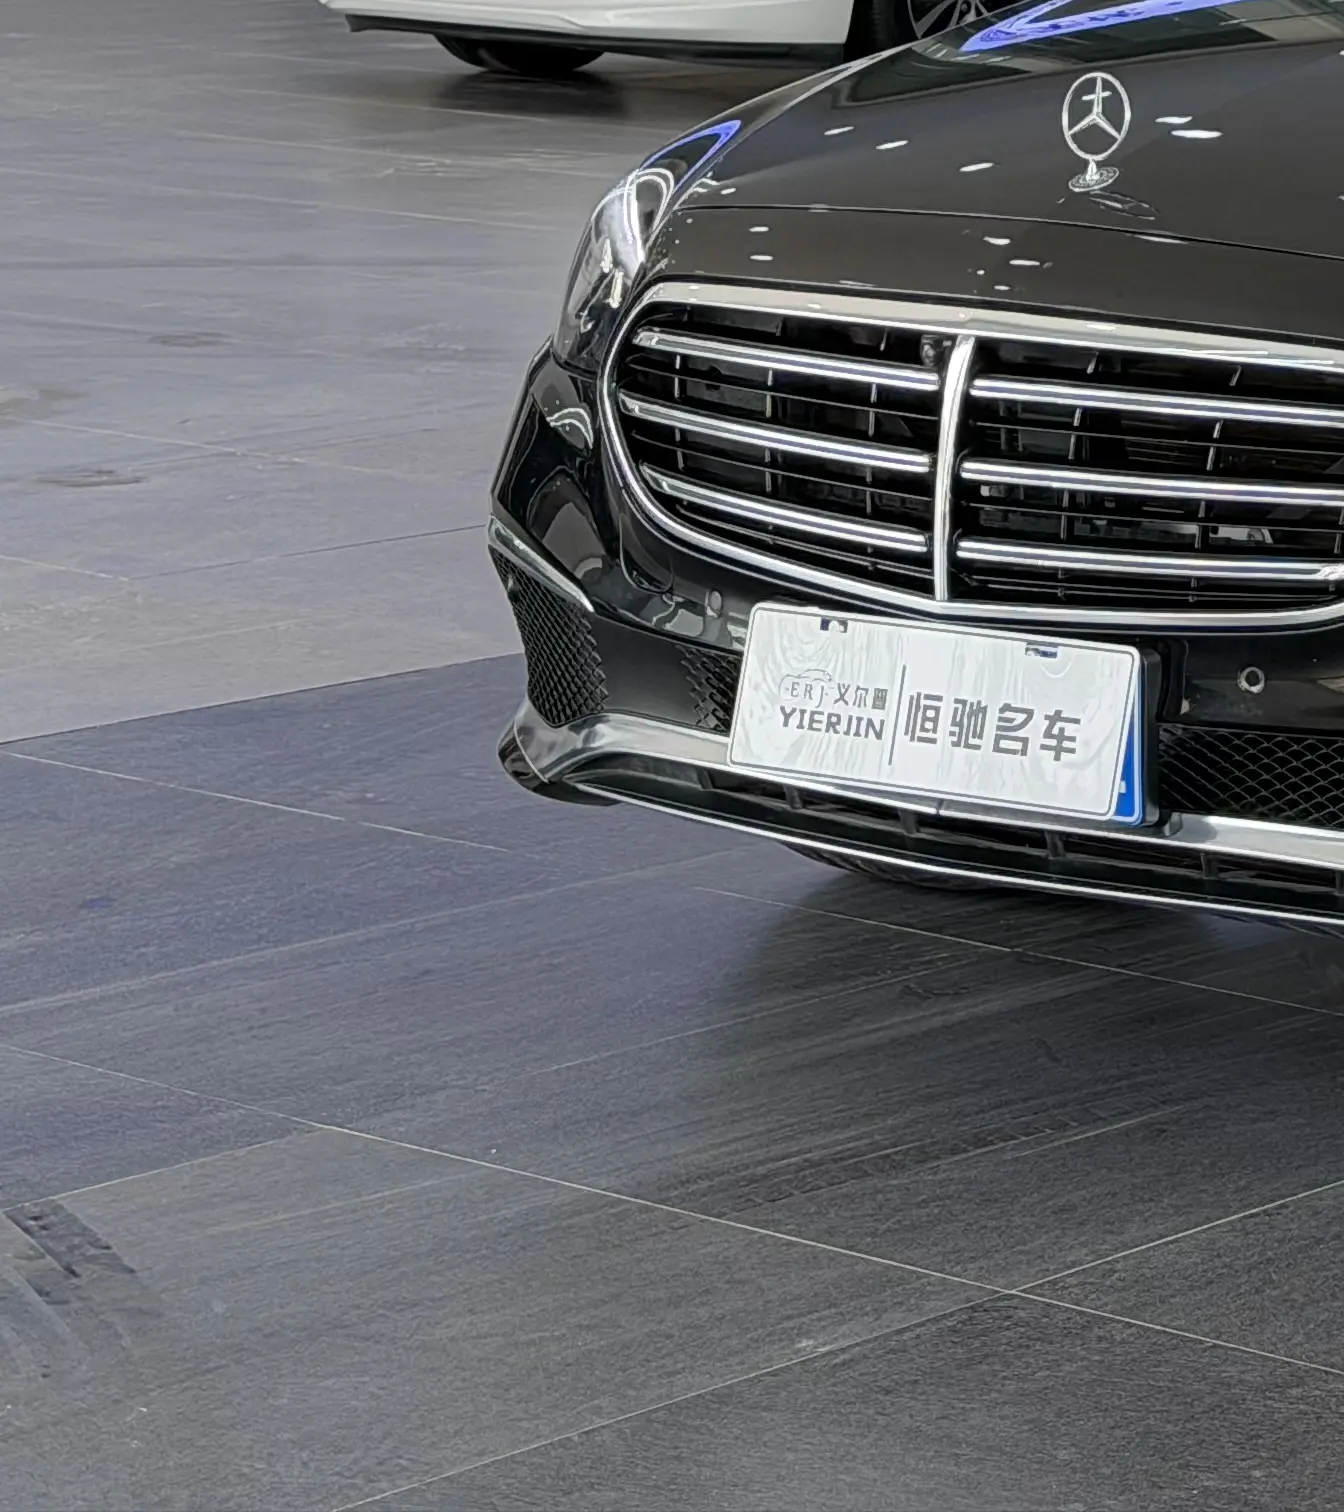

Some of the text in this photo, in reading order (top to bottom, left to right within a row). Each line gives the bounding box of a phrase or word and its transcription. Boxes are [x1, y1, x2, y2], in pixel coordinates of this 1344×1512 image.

[780, 705, 885, 741] YIERJIN
[904, 692, 1081, 762] 恒驰名车
